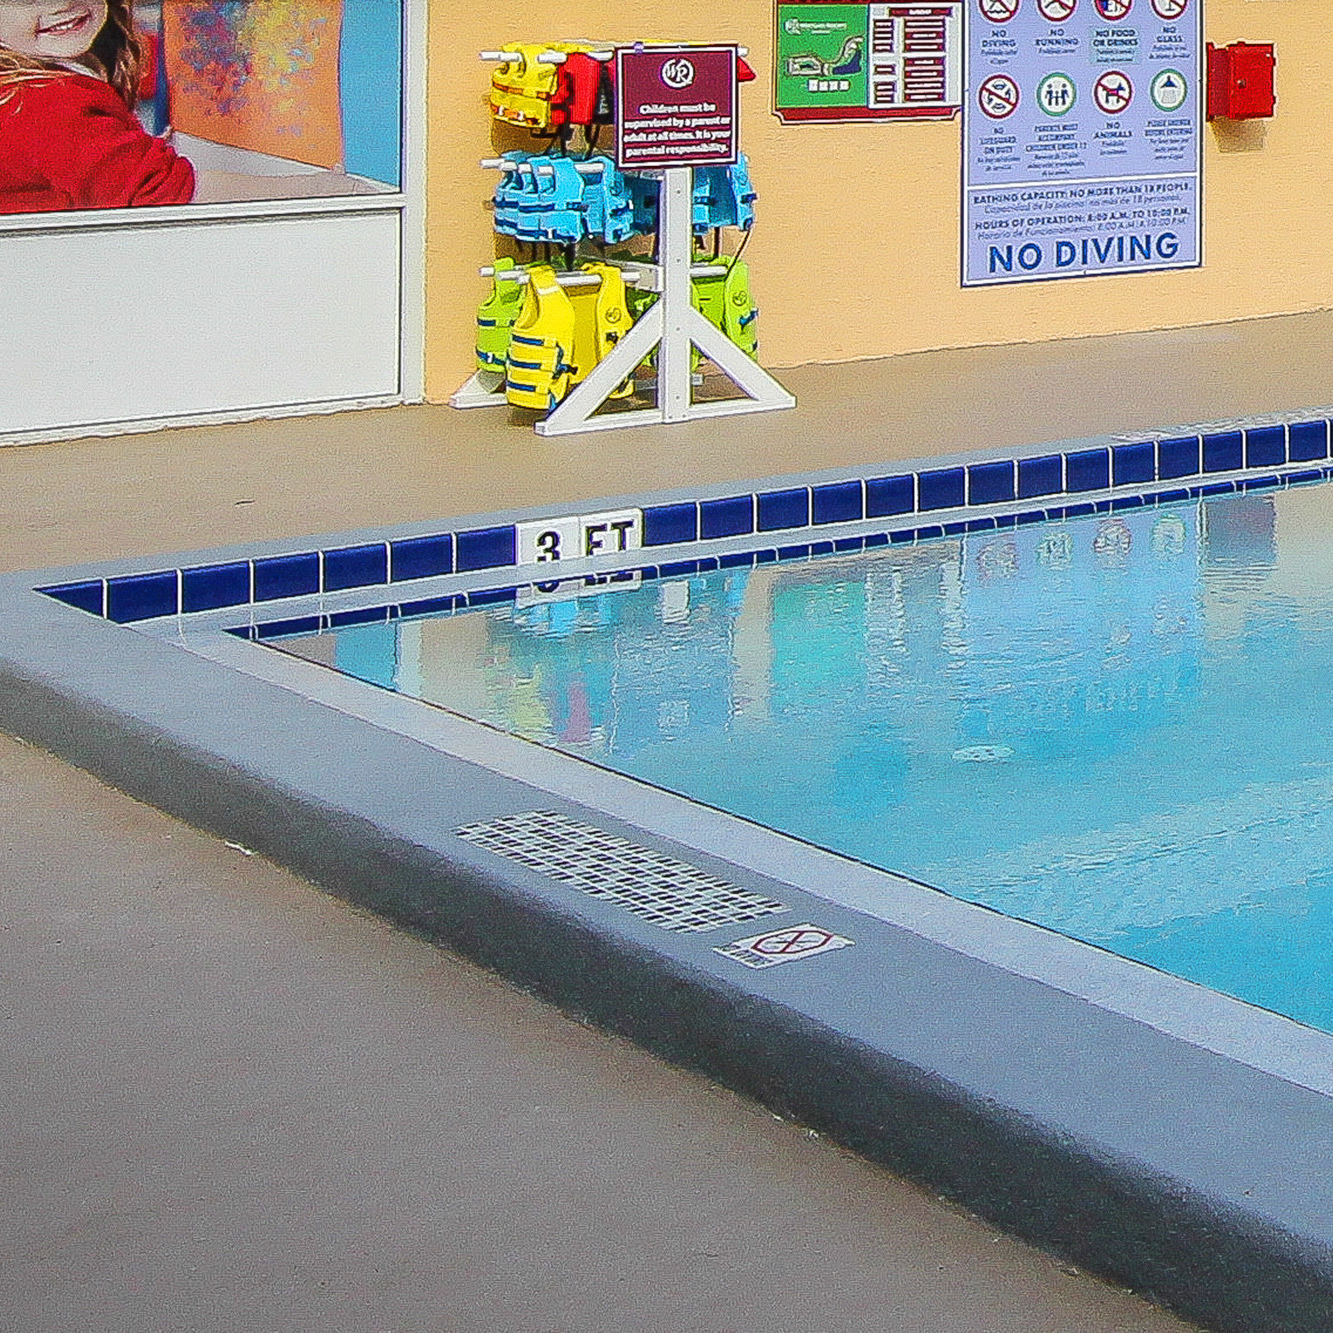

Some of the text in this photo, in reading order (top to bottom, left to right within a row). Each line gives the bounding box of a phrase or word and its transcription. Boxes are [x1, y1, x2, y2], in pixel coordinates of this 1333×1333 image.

[991, 29, 1007, 38] NO
[1049, 28, 1065, 37] NO
[1095, 29, 1109, 38] NO
[1162, 26, 1177, 34] NO
[981, 39, 1016, 47] DIVING
[1106, 121, 1121, 130] NO
[1069, 189, 1085, 199] NO
[1116, 185, 1142, 196] THAN
[974, 219, 1010, 231] HOURS
[1011, 218, 1024, 228] OF
[1132, 209, 1145, 219] TO
[989, 232, 1179, 273] NO DIVING
[536, 519, 635, 562] 3 FT
